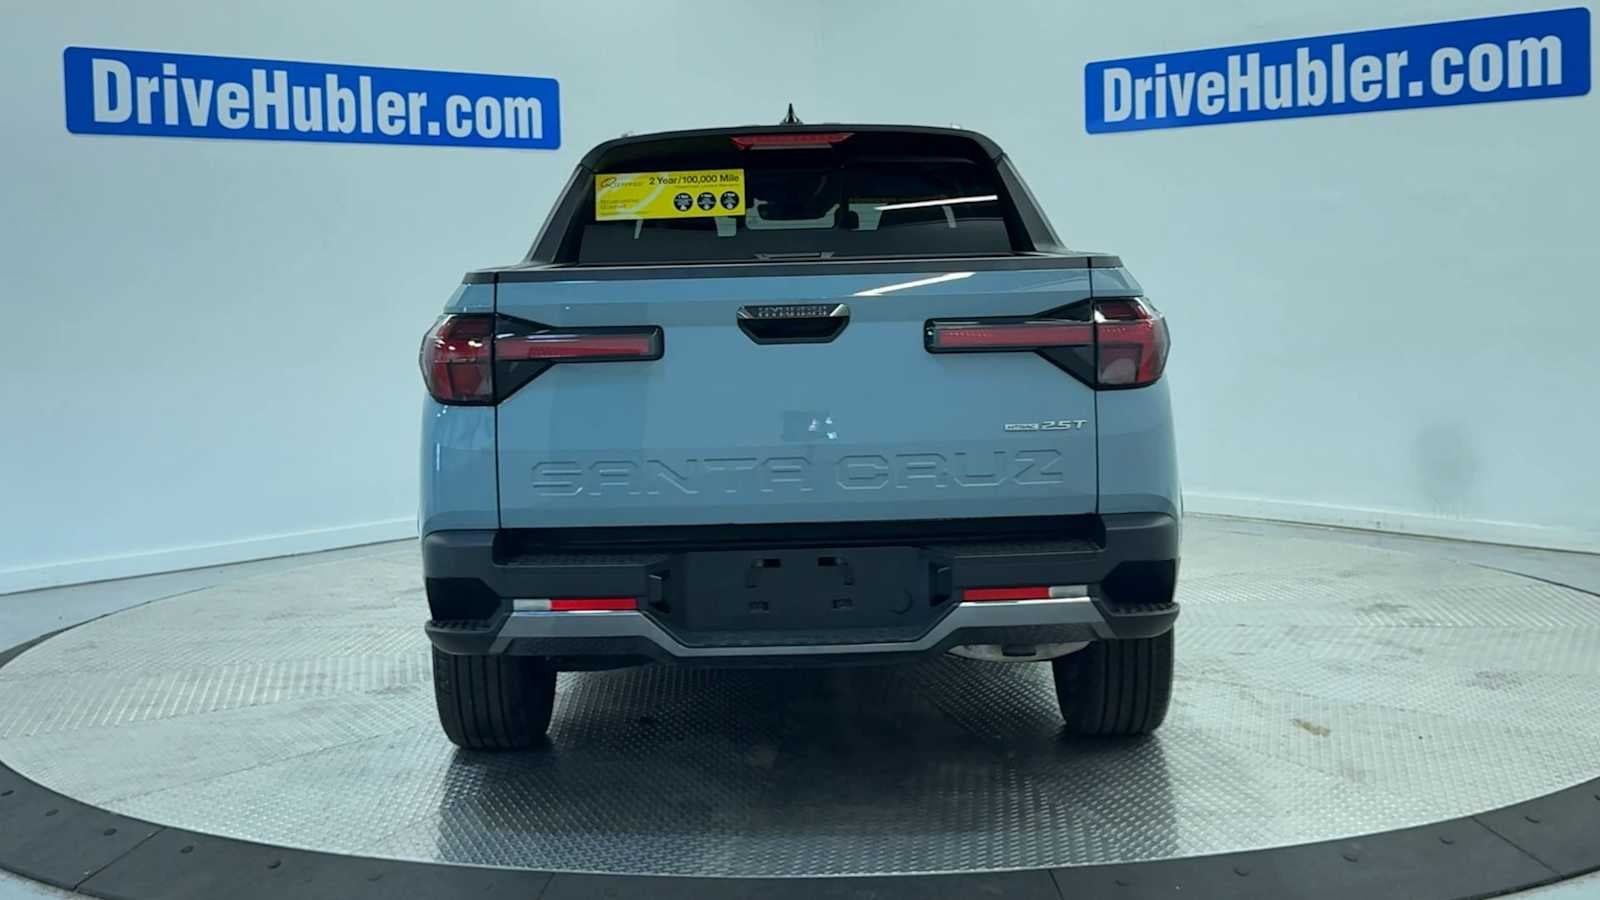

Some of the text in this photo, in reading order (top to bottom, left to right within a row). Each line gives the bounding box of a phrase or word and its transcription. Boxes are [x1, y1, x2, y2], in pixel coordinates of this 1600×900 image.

[91, 57, 544, 140] DriveHubler.com
[1103, 35, 1563, 123] DriveHubler.com
[648, 177, 656, 185] 2
[657, 174, 718, 185] Year/100,000
[720, 173, 741, 182] Mile
[531, 448, 1064, 497] SANTA CRUZ
